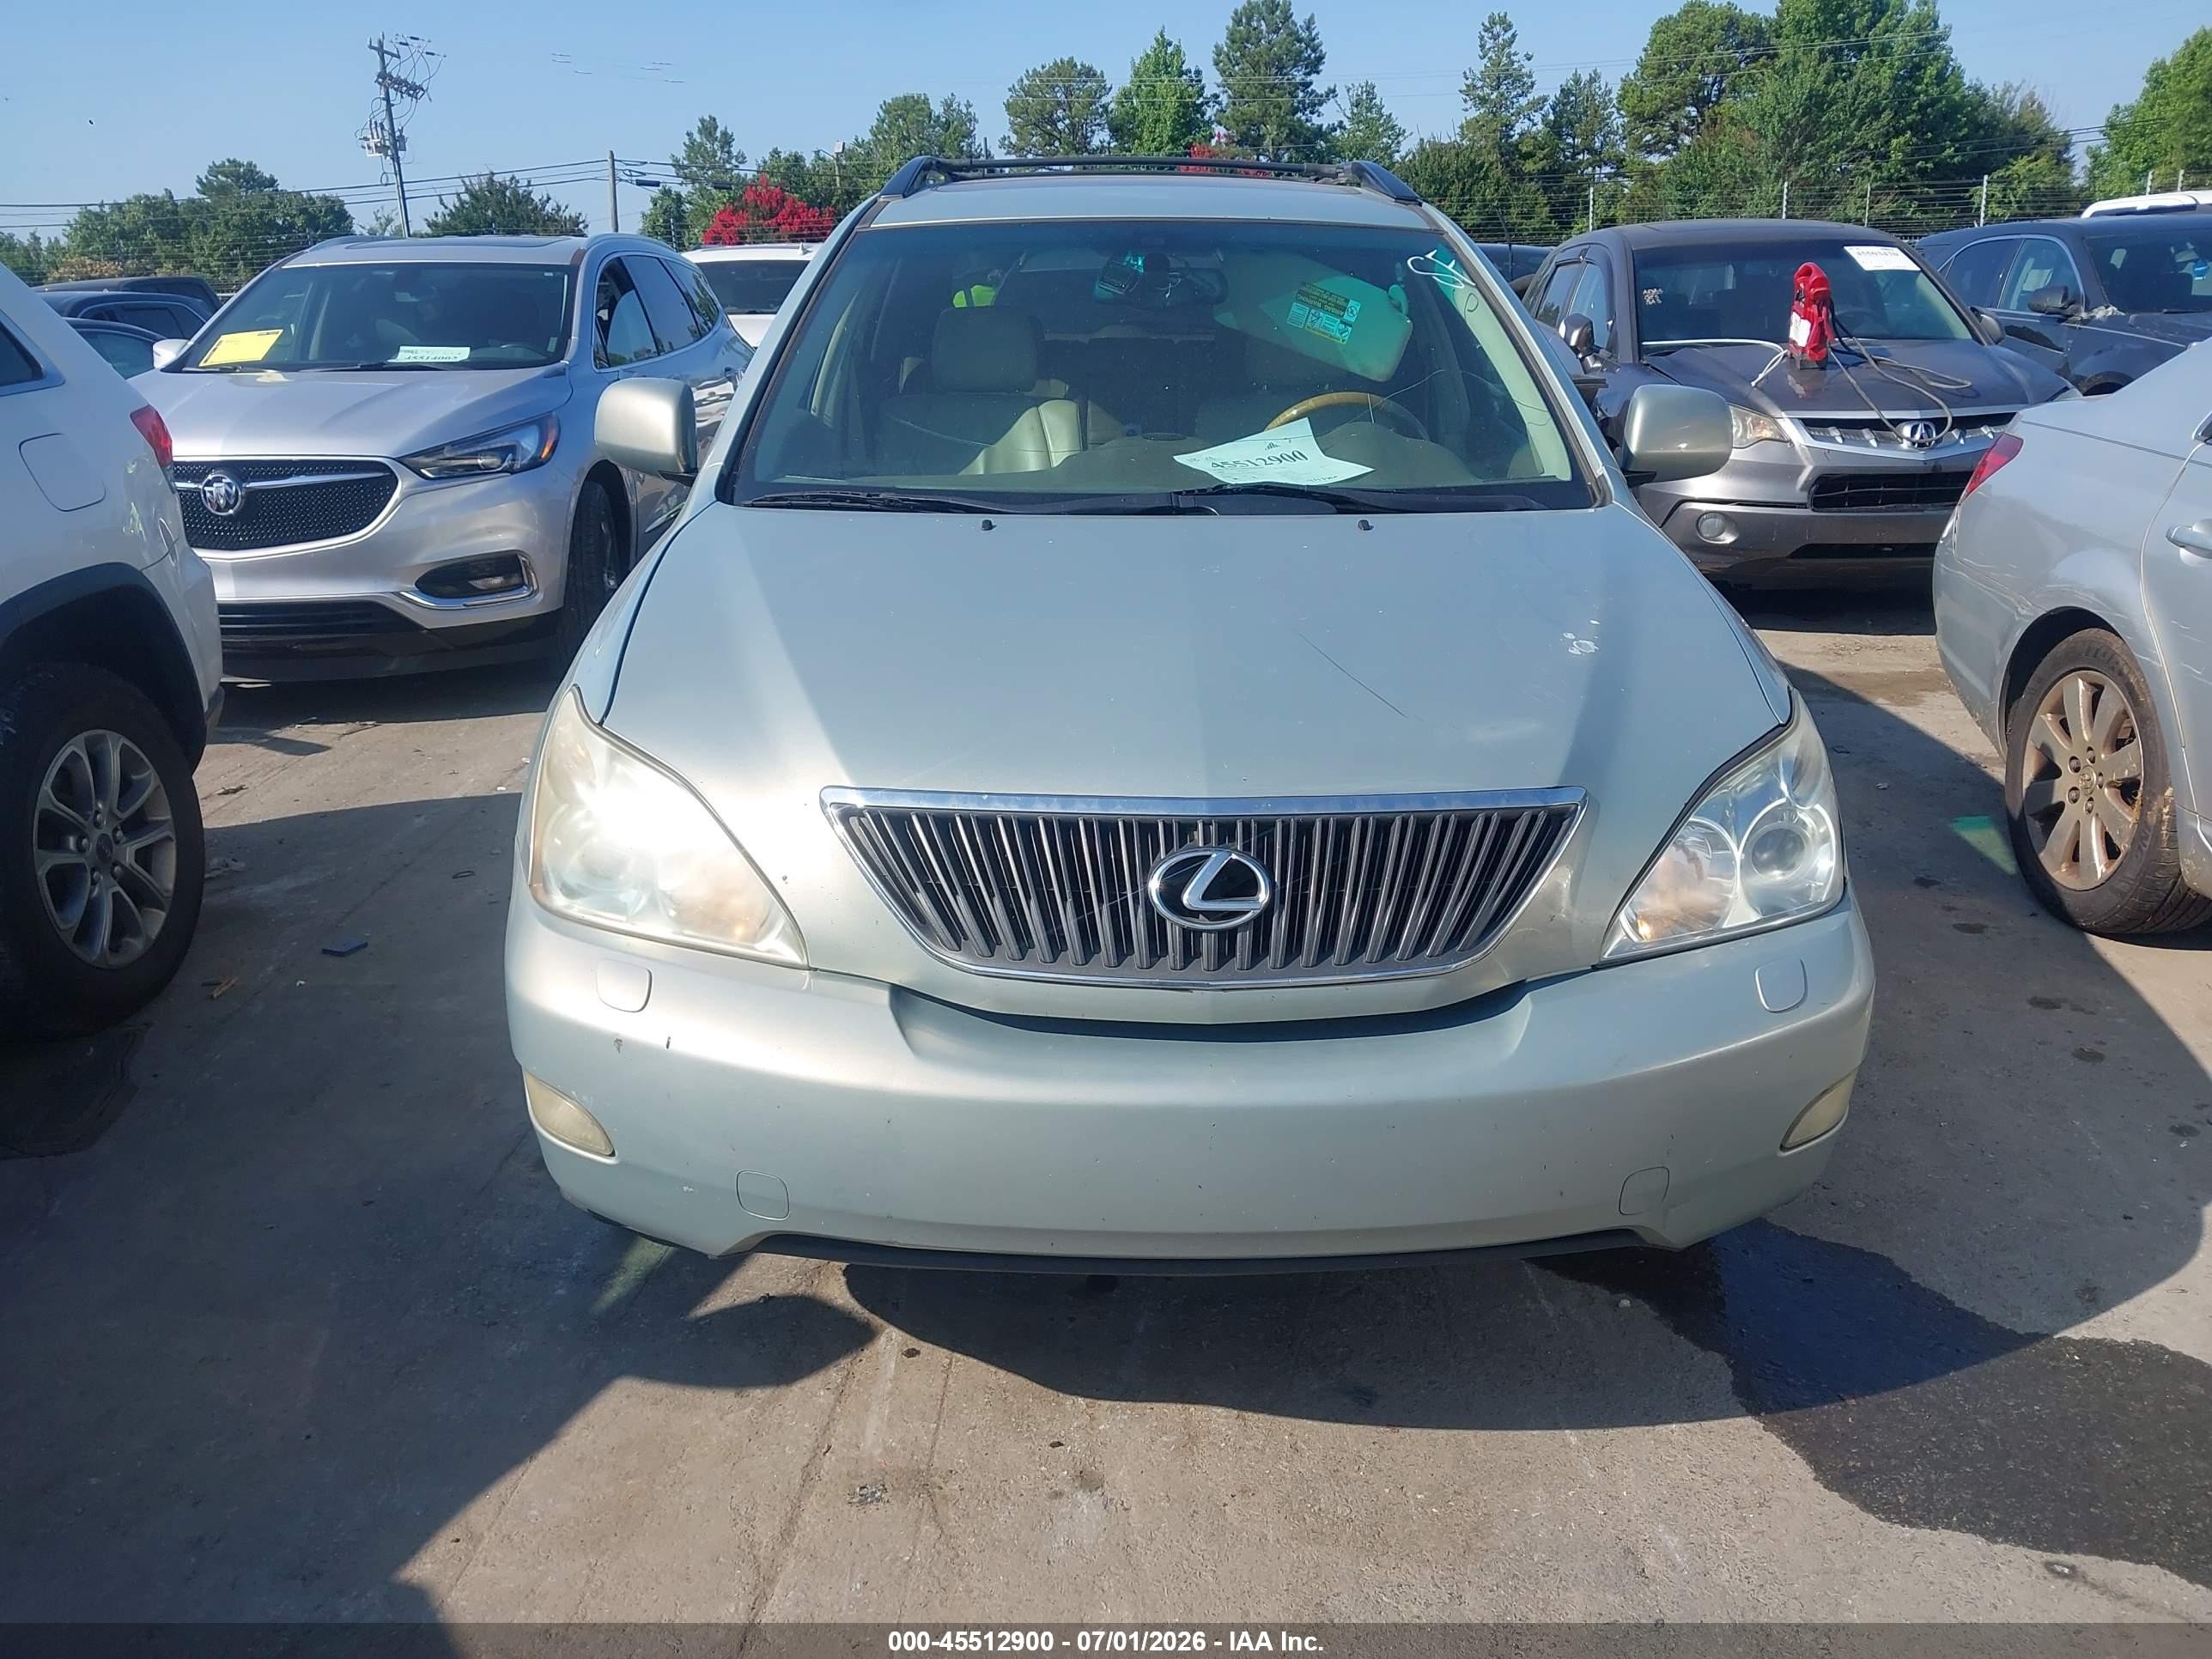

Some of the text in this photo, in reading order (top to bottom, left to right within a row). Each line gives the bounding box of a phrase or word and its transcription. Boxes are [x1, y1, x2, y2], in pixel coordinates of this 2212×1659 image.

[1297, 293, 1322, 308] WARNING
[1323, 304, 1345, 317] AIRBAG
[1210, 449, 1309, 470] 45512900
